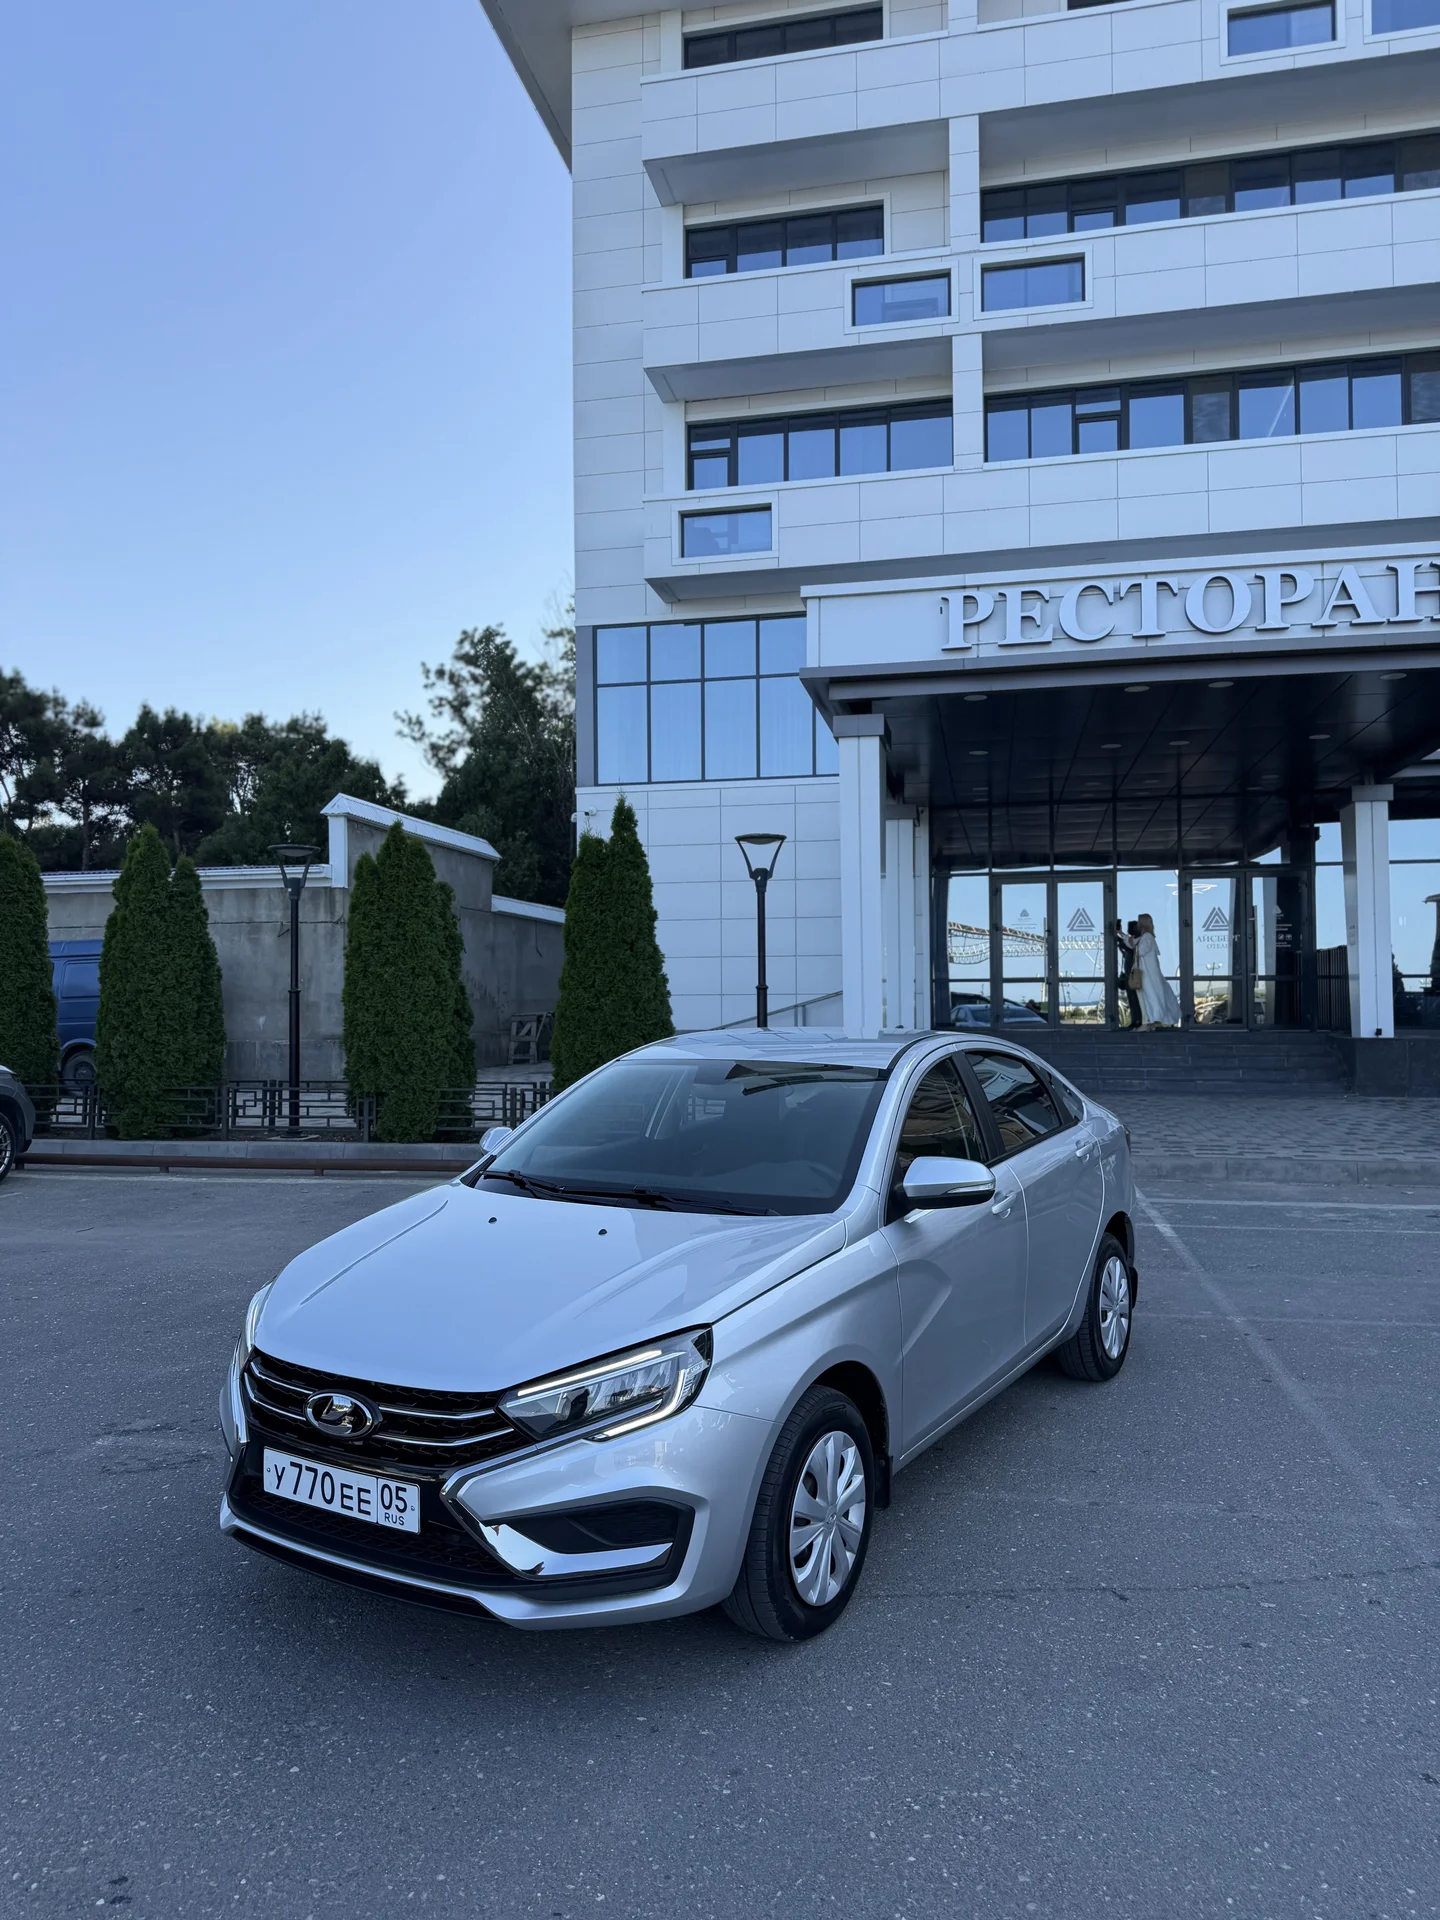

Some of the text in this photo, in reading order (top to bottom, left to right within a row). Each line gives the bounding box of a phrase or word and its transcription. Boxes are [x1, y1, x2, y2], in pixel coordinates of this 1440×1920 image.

[940, 561, 1440, 652] РЕСТОРАН
[1196, 934, 1241, 943] АЙСБЕГ
[273, 1461, 408, 1516] У770ЕЕ 05
[384, 1512, 406, 1527] RUS
